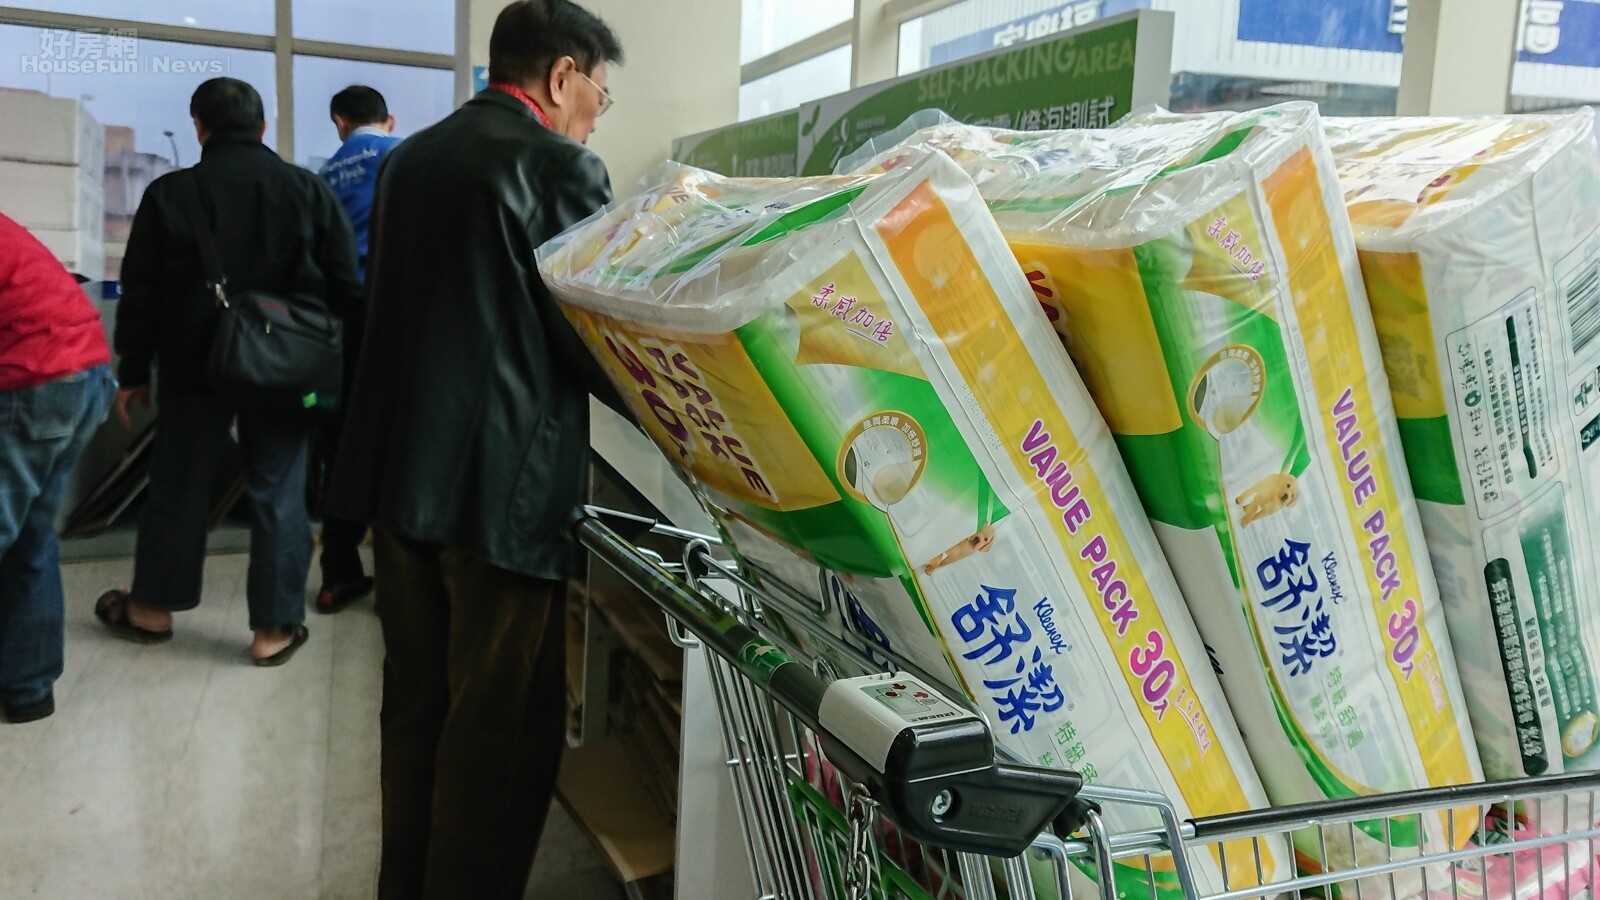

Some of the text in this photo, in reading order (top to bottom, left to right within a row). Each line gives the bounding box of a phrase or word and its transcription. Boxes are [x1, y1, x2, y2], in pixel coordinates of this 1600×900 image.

[1072, 39, 1134, 78] AREA
[811, 283, 894, 343] 柔感加倍
[1022, 419, 1092, 533] VALUE
[1081, 535, 1139, 635] PACK
[1333, 387, 1377, 506] VALUE
[1363, 509, 1401, 601] PACK
[1032, 596, 1068, 655] Kleenex
[1256, 538, 1337, 677] 舒潔
[1321, 551, 1344, 605] Kleenex
[951, 583, 1066, 735] 舒潔
